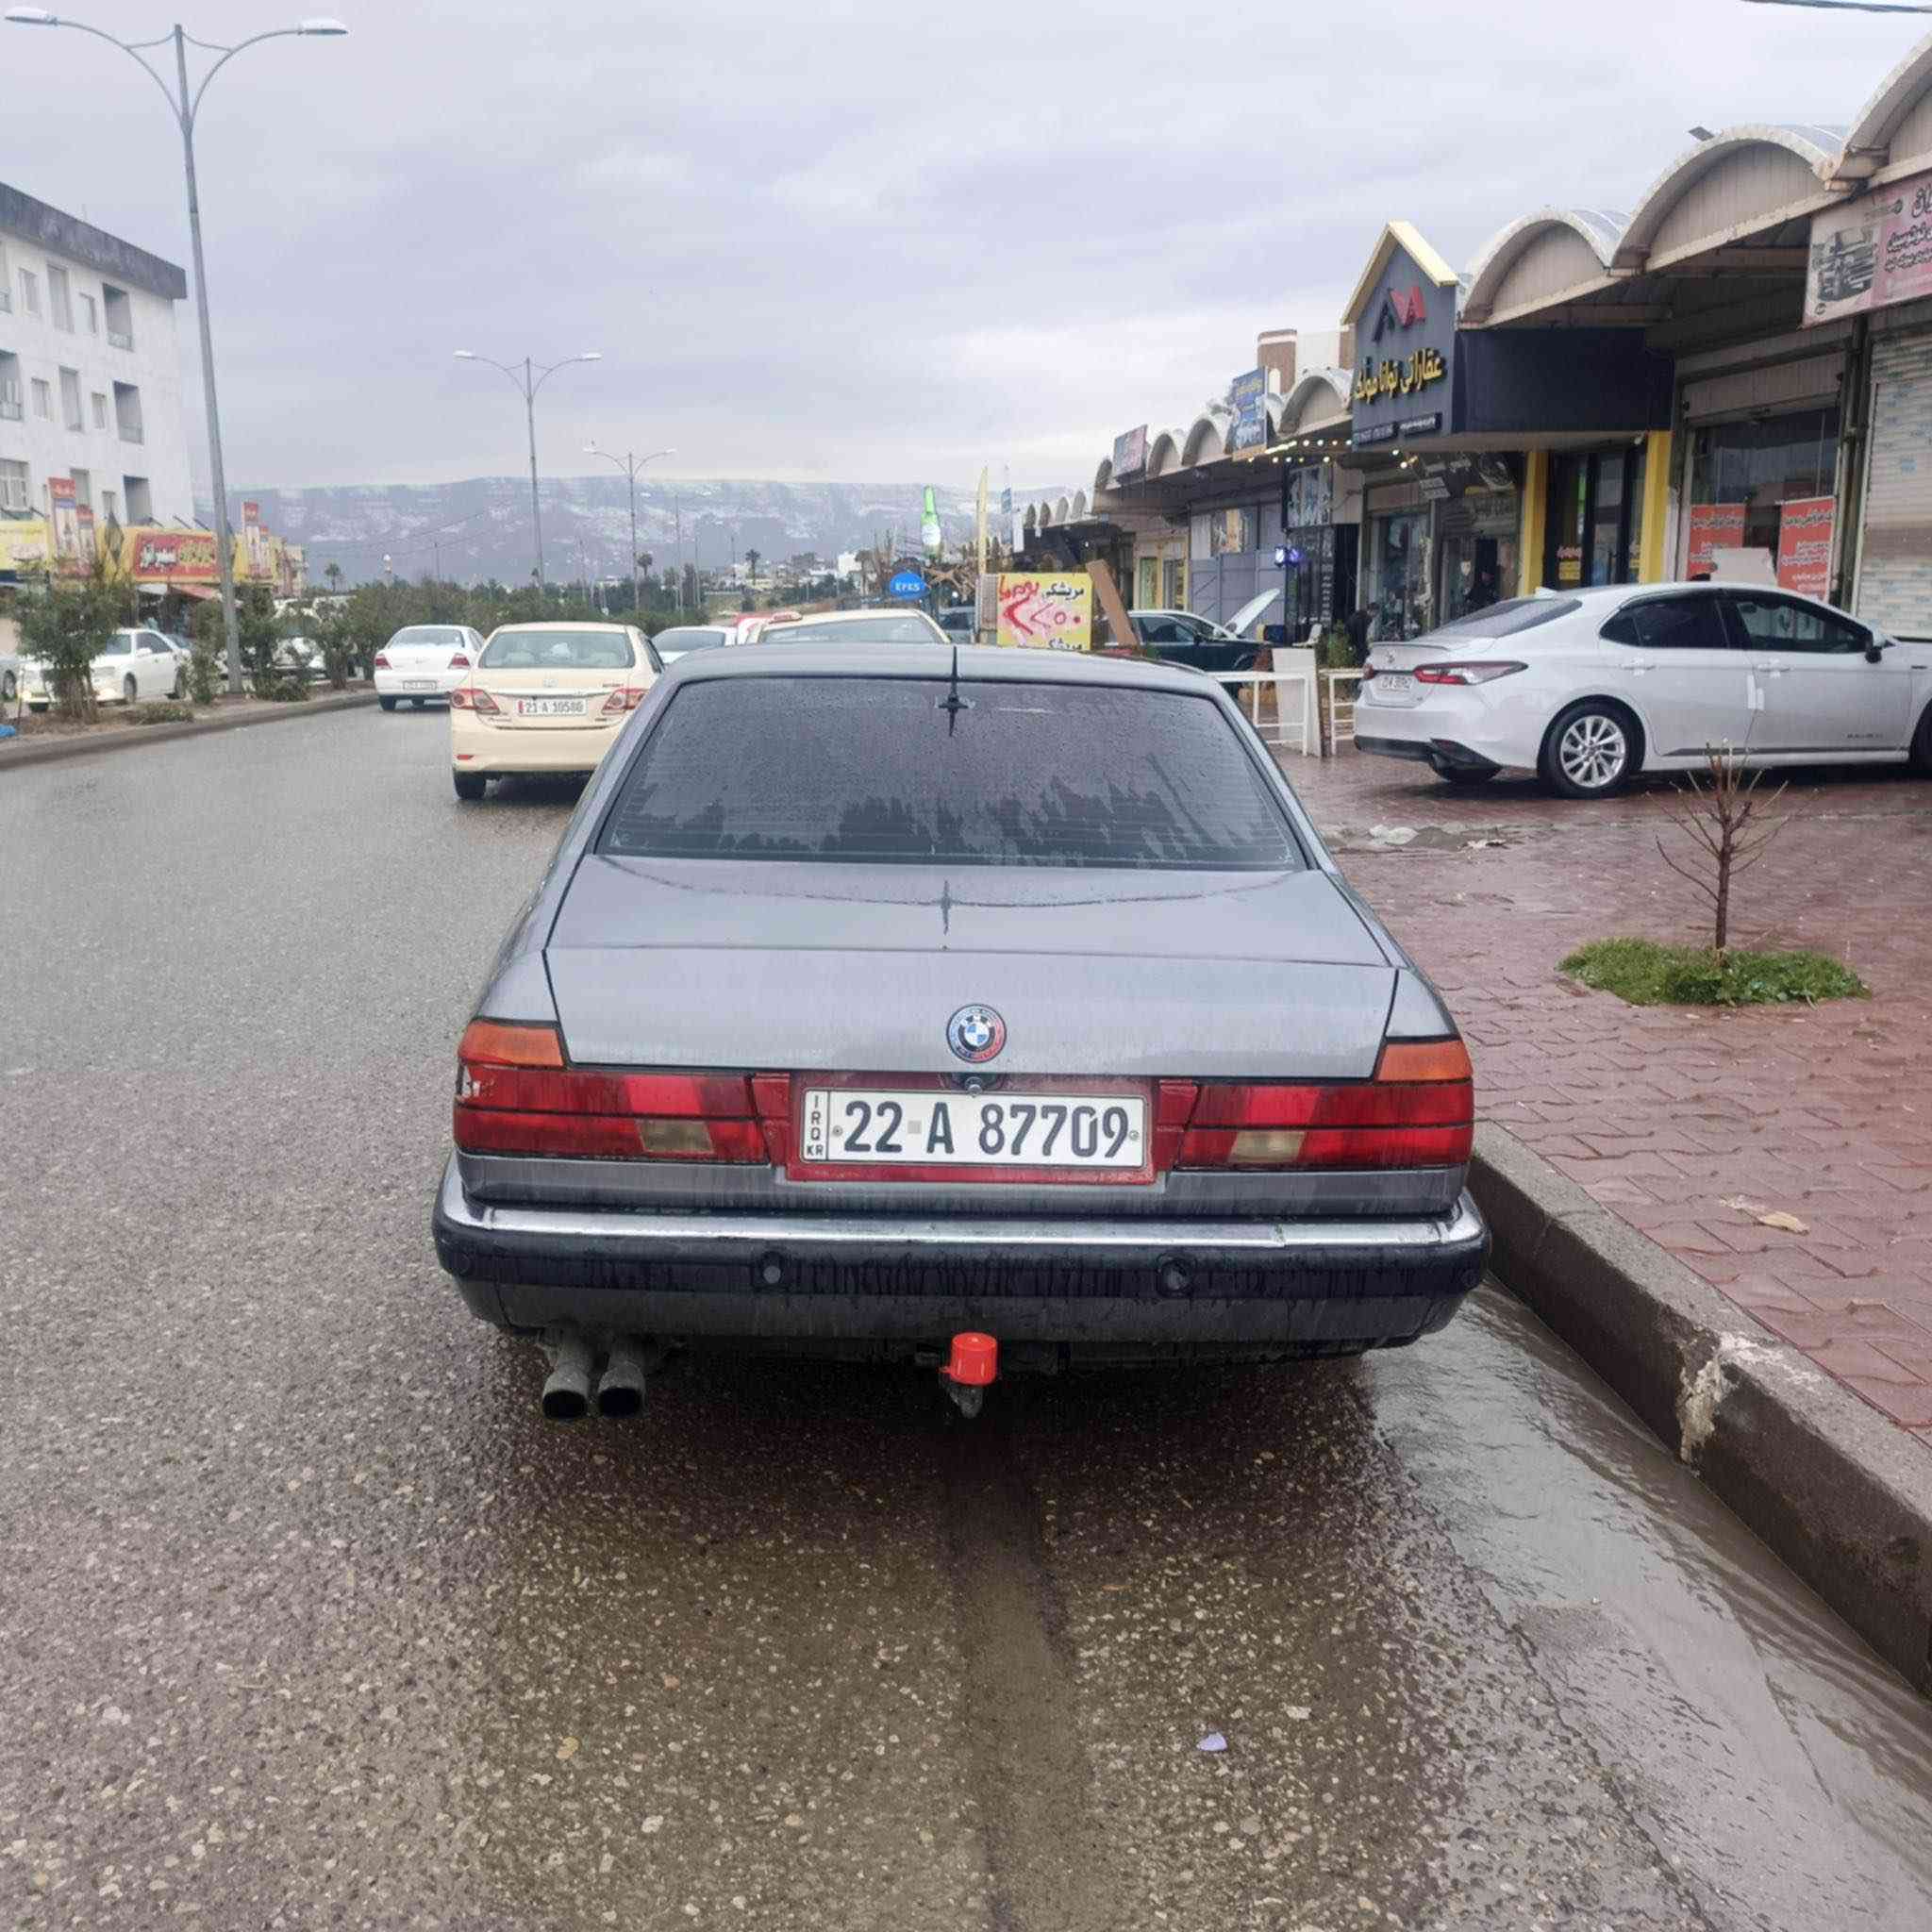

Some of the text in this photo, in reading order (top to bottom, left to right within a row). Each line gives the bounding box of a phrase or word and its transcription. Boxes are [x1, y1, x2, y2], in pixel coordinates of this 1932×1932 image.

[843, 1100, 1129, 1158] 22 A 87709
[806, 1143, 824, 1157] KR
